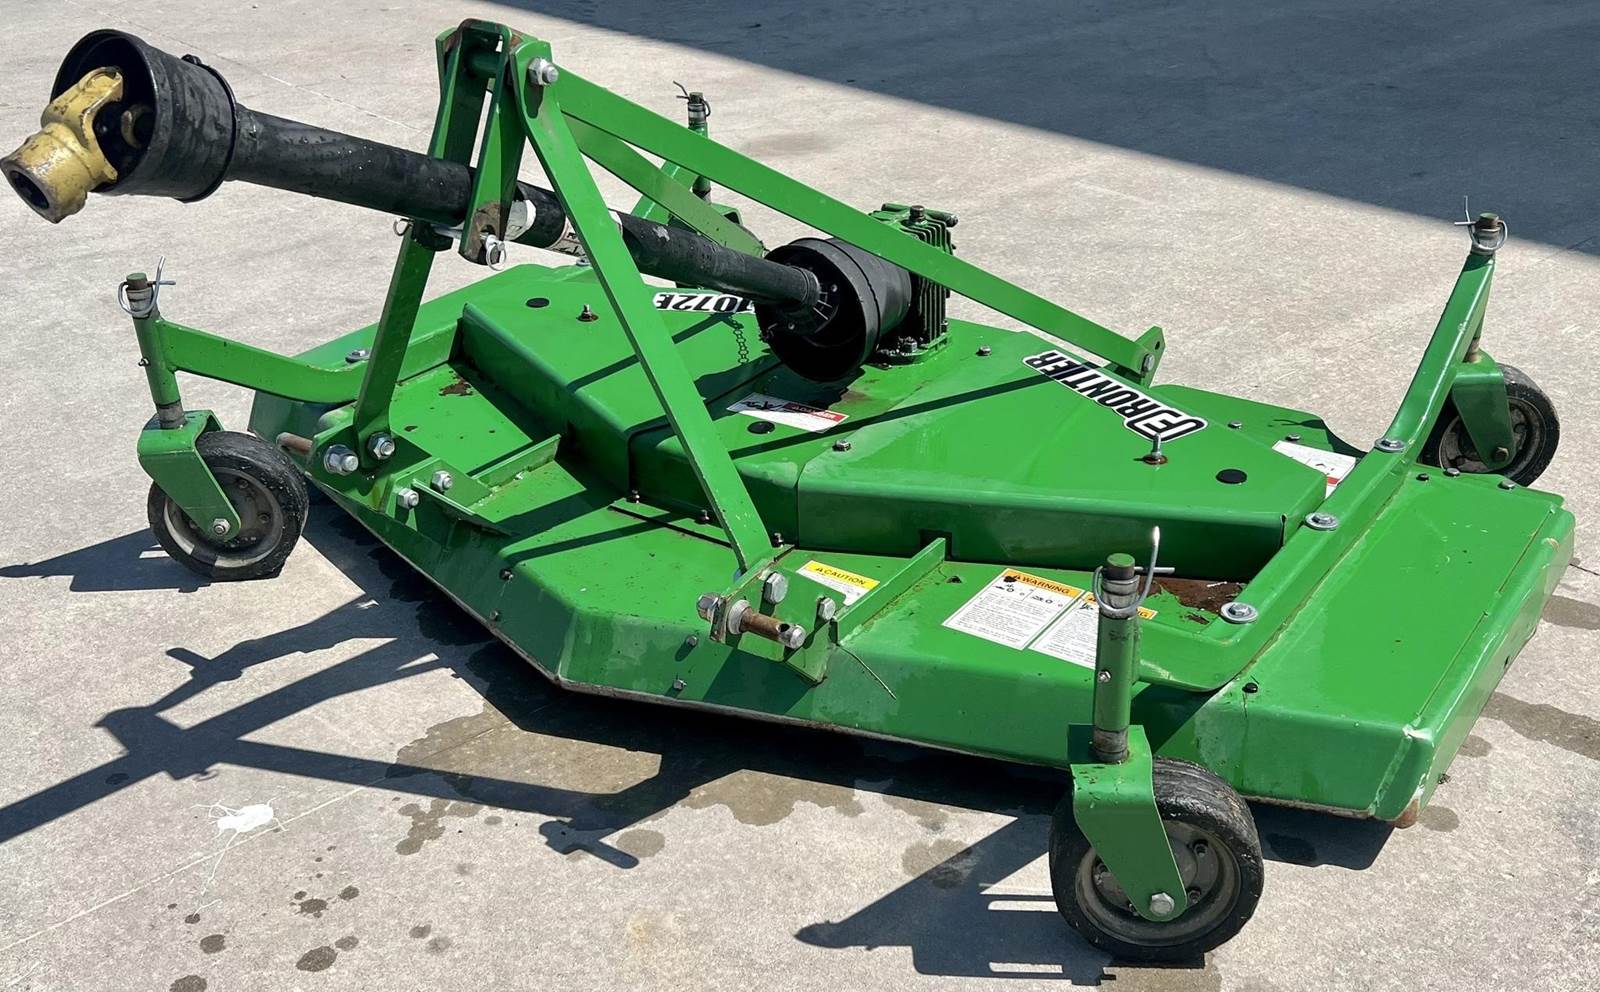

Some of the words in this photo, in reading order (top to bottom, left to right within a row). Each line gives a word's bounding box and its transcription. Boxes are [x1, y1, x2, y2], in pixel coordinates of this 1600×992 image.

[656, 294, 755, 313] 1072E
[1025, 351, 1207, 442] FRONTIER
[823, 568, 867, 586] CAUTION
[1022, 576, 1071, 594] WARNING
